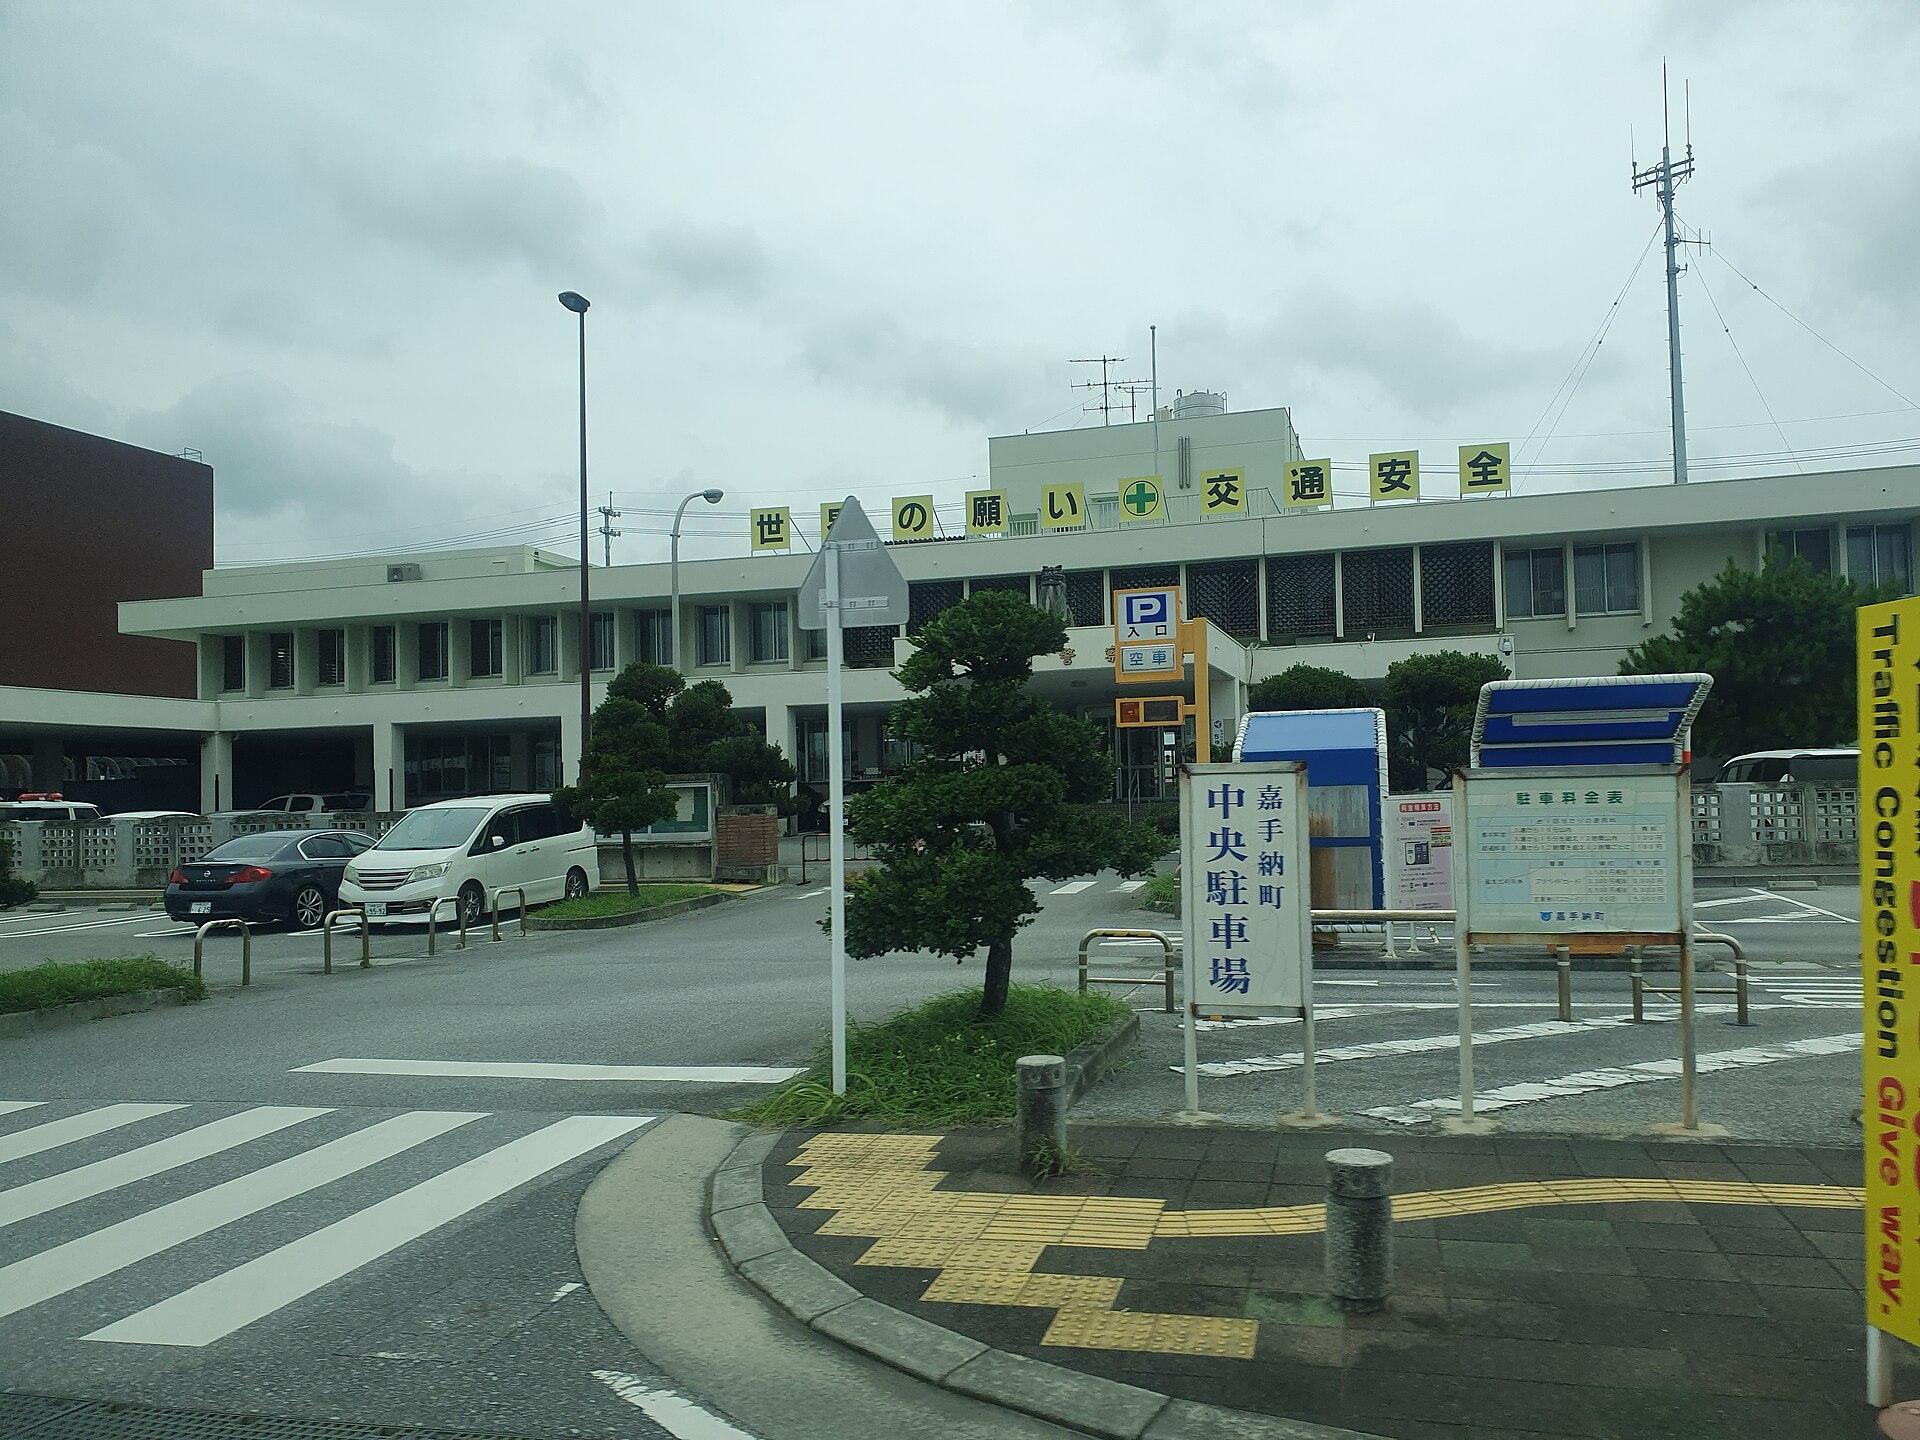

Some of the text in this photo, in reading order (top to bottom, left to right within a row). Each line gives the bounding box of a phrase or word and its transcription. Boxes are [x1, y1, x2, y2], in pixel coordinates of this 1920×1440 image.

[1206, 450, 1504, 508] 交通安全
[1127, 624, 1168, 638] 入口
[1132, 597, 1161, 623] P
[1129, 650, 1168, 666] 空車
[1872, 613, 1901, 768] Traffic
[1516, 790, 1623, 806] 駐車料金表
[1257, 784, 1285, 909] 嘉手納町
[1206, 783, 1251, 995] 中央駐車場
[1873, 785, 1904, 1058] Congestion
